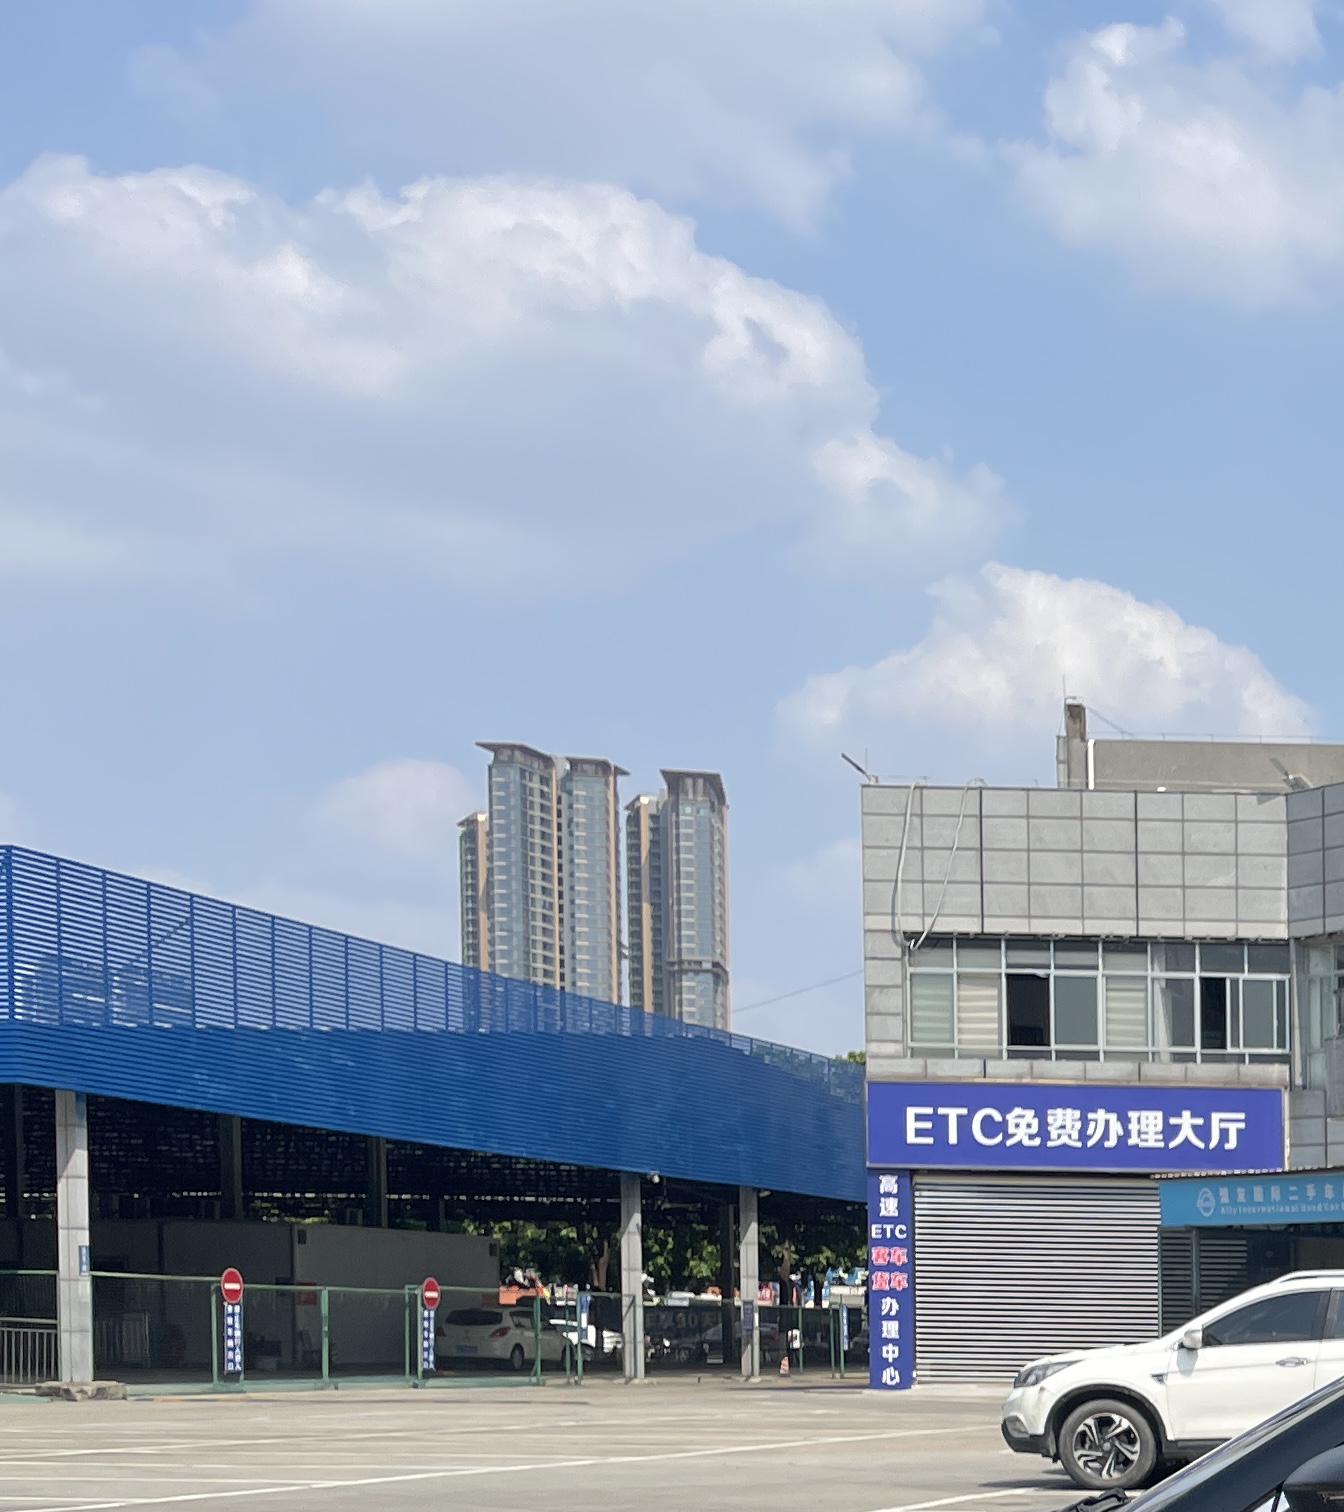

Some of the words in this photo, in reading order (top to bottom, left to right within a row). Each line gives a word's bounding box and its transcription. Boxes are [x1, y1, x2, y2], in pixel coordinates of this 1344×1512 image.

[905, 1106, 1246, 1150] ETC免费办理大厅
[878, 1174, 899, 1217] 高速
[871, 1224, 907, 1239] ETC
[871, 1271, 908, 1292] 货车
[881, 1296, 900, 1386] 办理中心
